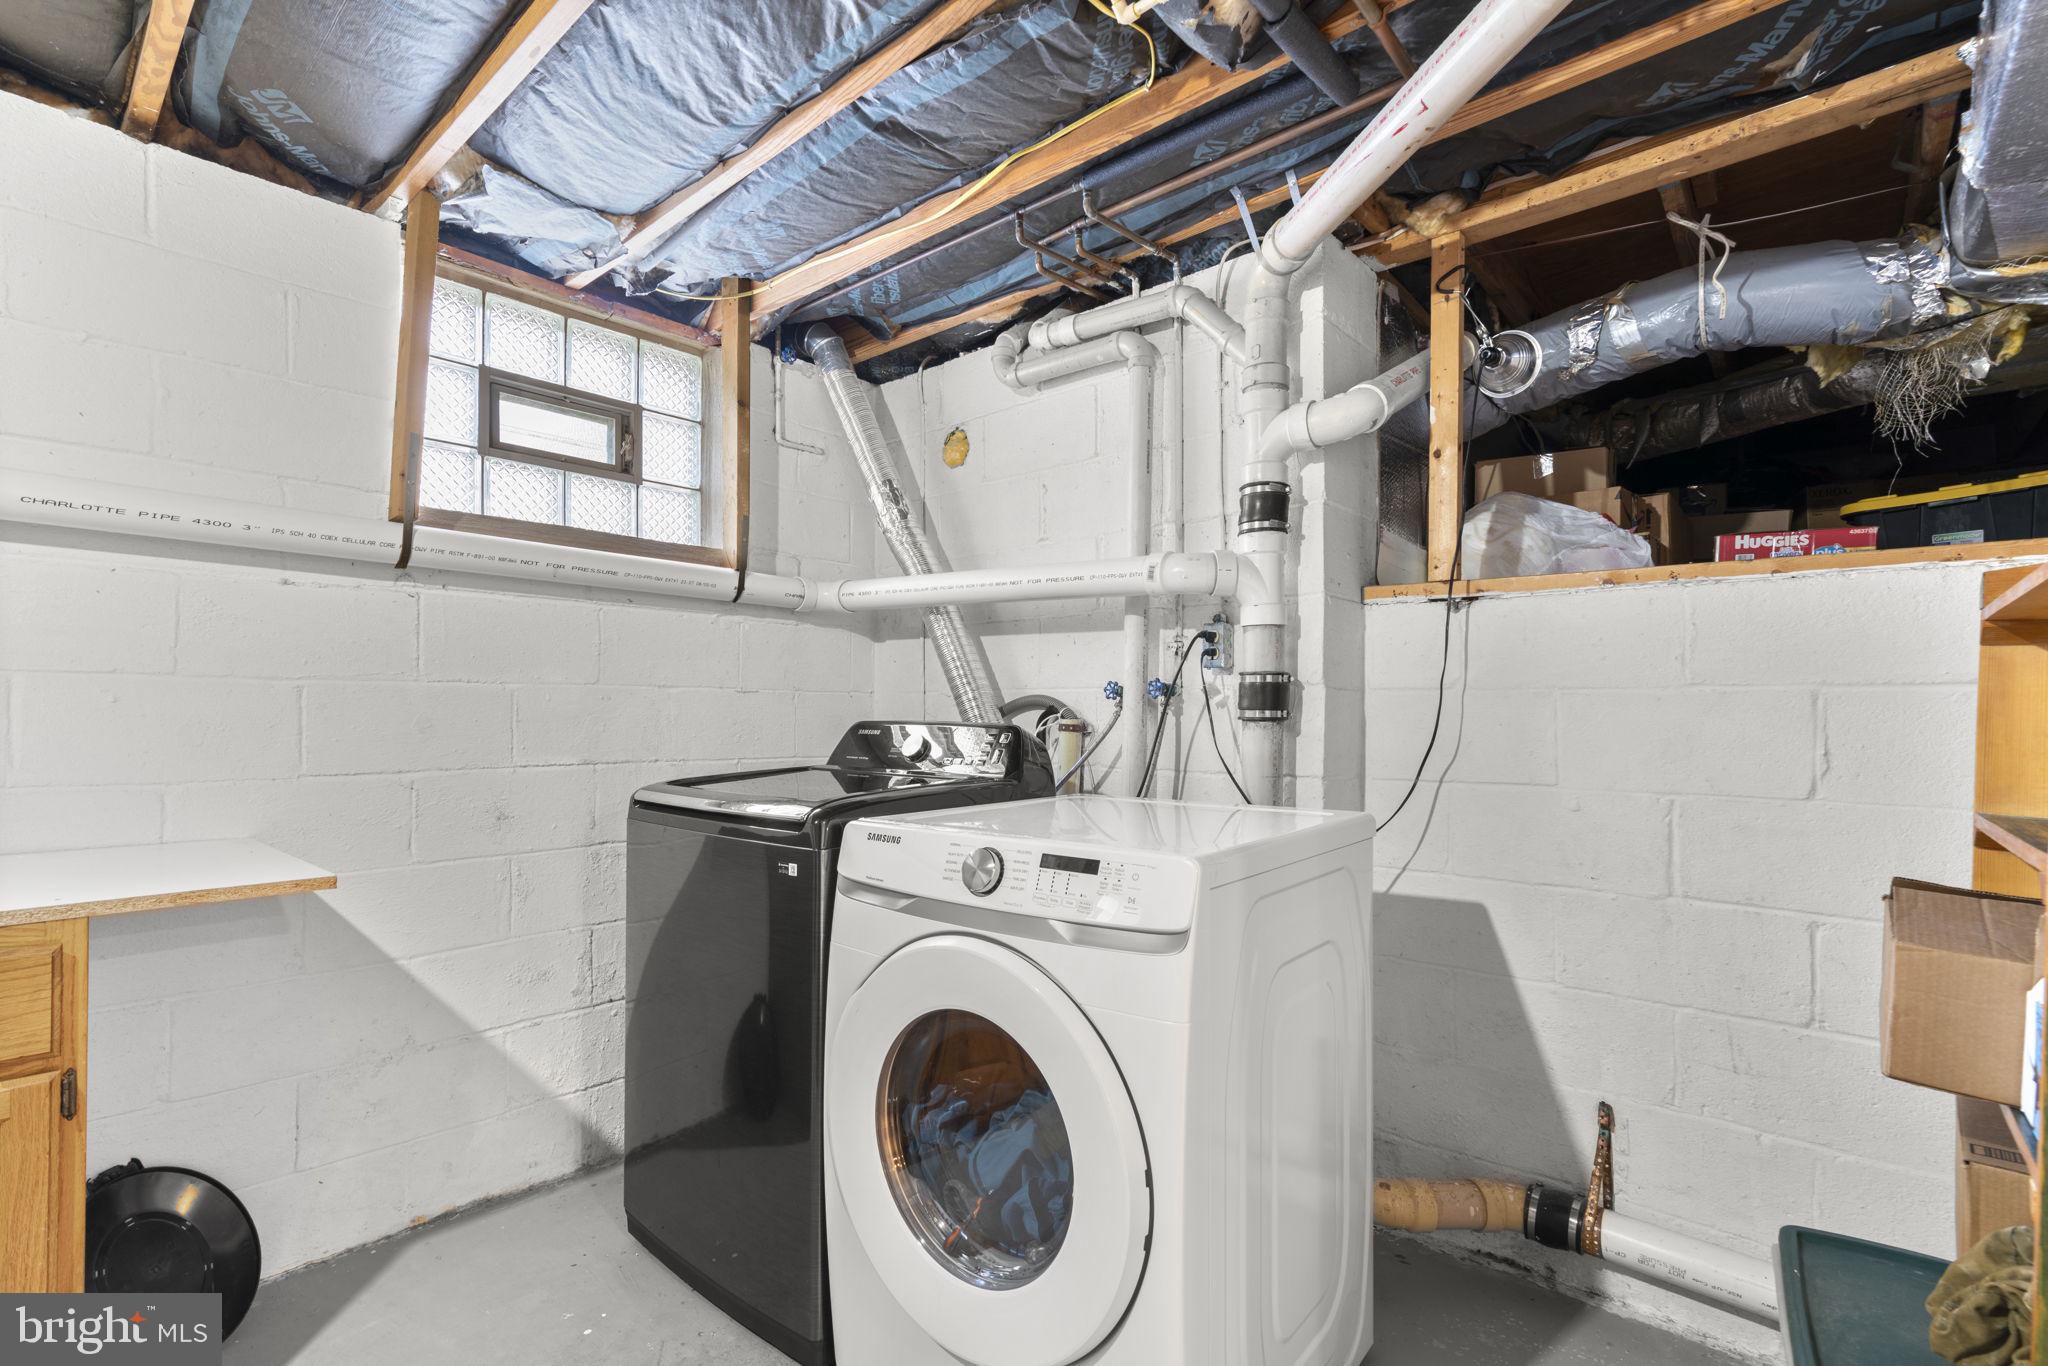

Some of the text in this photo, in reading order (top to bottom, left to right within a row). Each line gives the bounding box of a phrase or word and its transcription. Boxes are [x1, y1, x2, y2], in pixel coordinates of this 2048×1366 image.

[20, 496, 126, 516] CHARLOTTE
[138, 511, 181, 522] PIPE
[192, 518, 232, 528] 4300
[342, 536, 376, 546] CELLULAR
[379, 541, 396, 549] CORE
[546, 562, 566, 570] FOR
[572, 566, 620, 577] PRESSURE
[1046, 575, 1085, 583] PRESSURE
[867, 832, 902, 844] SAMSUNG
